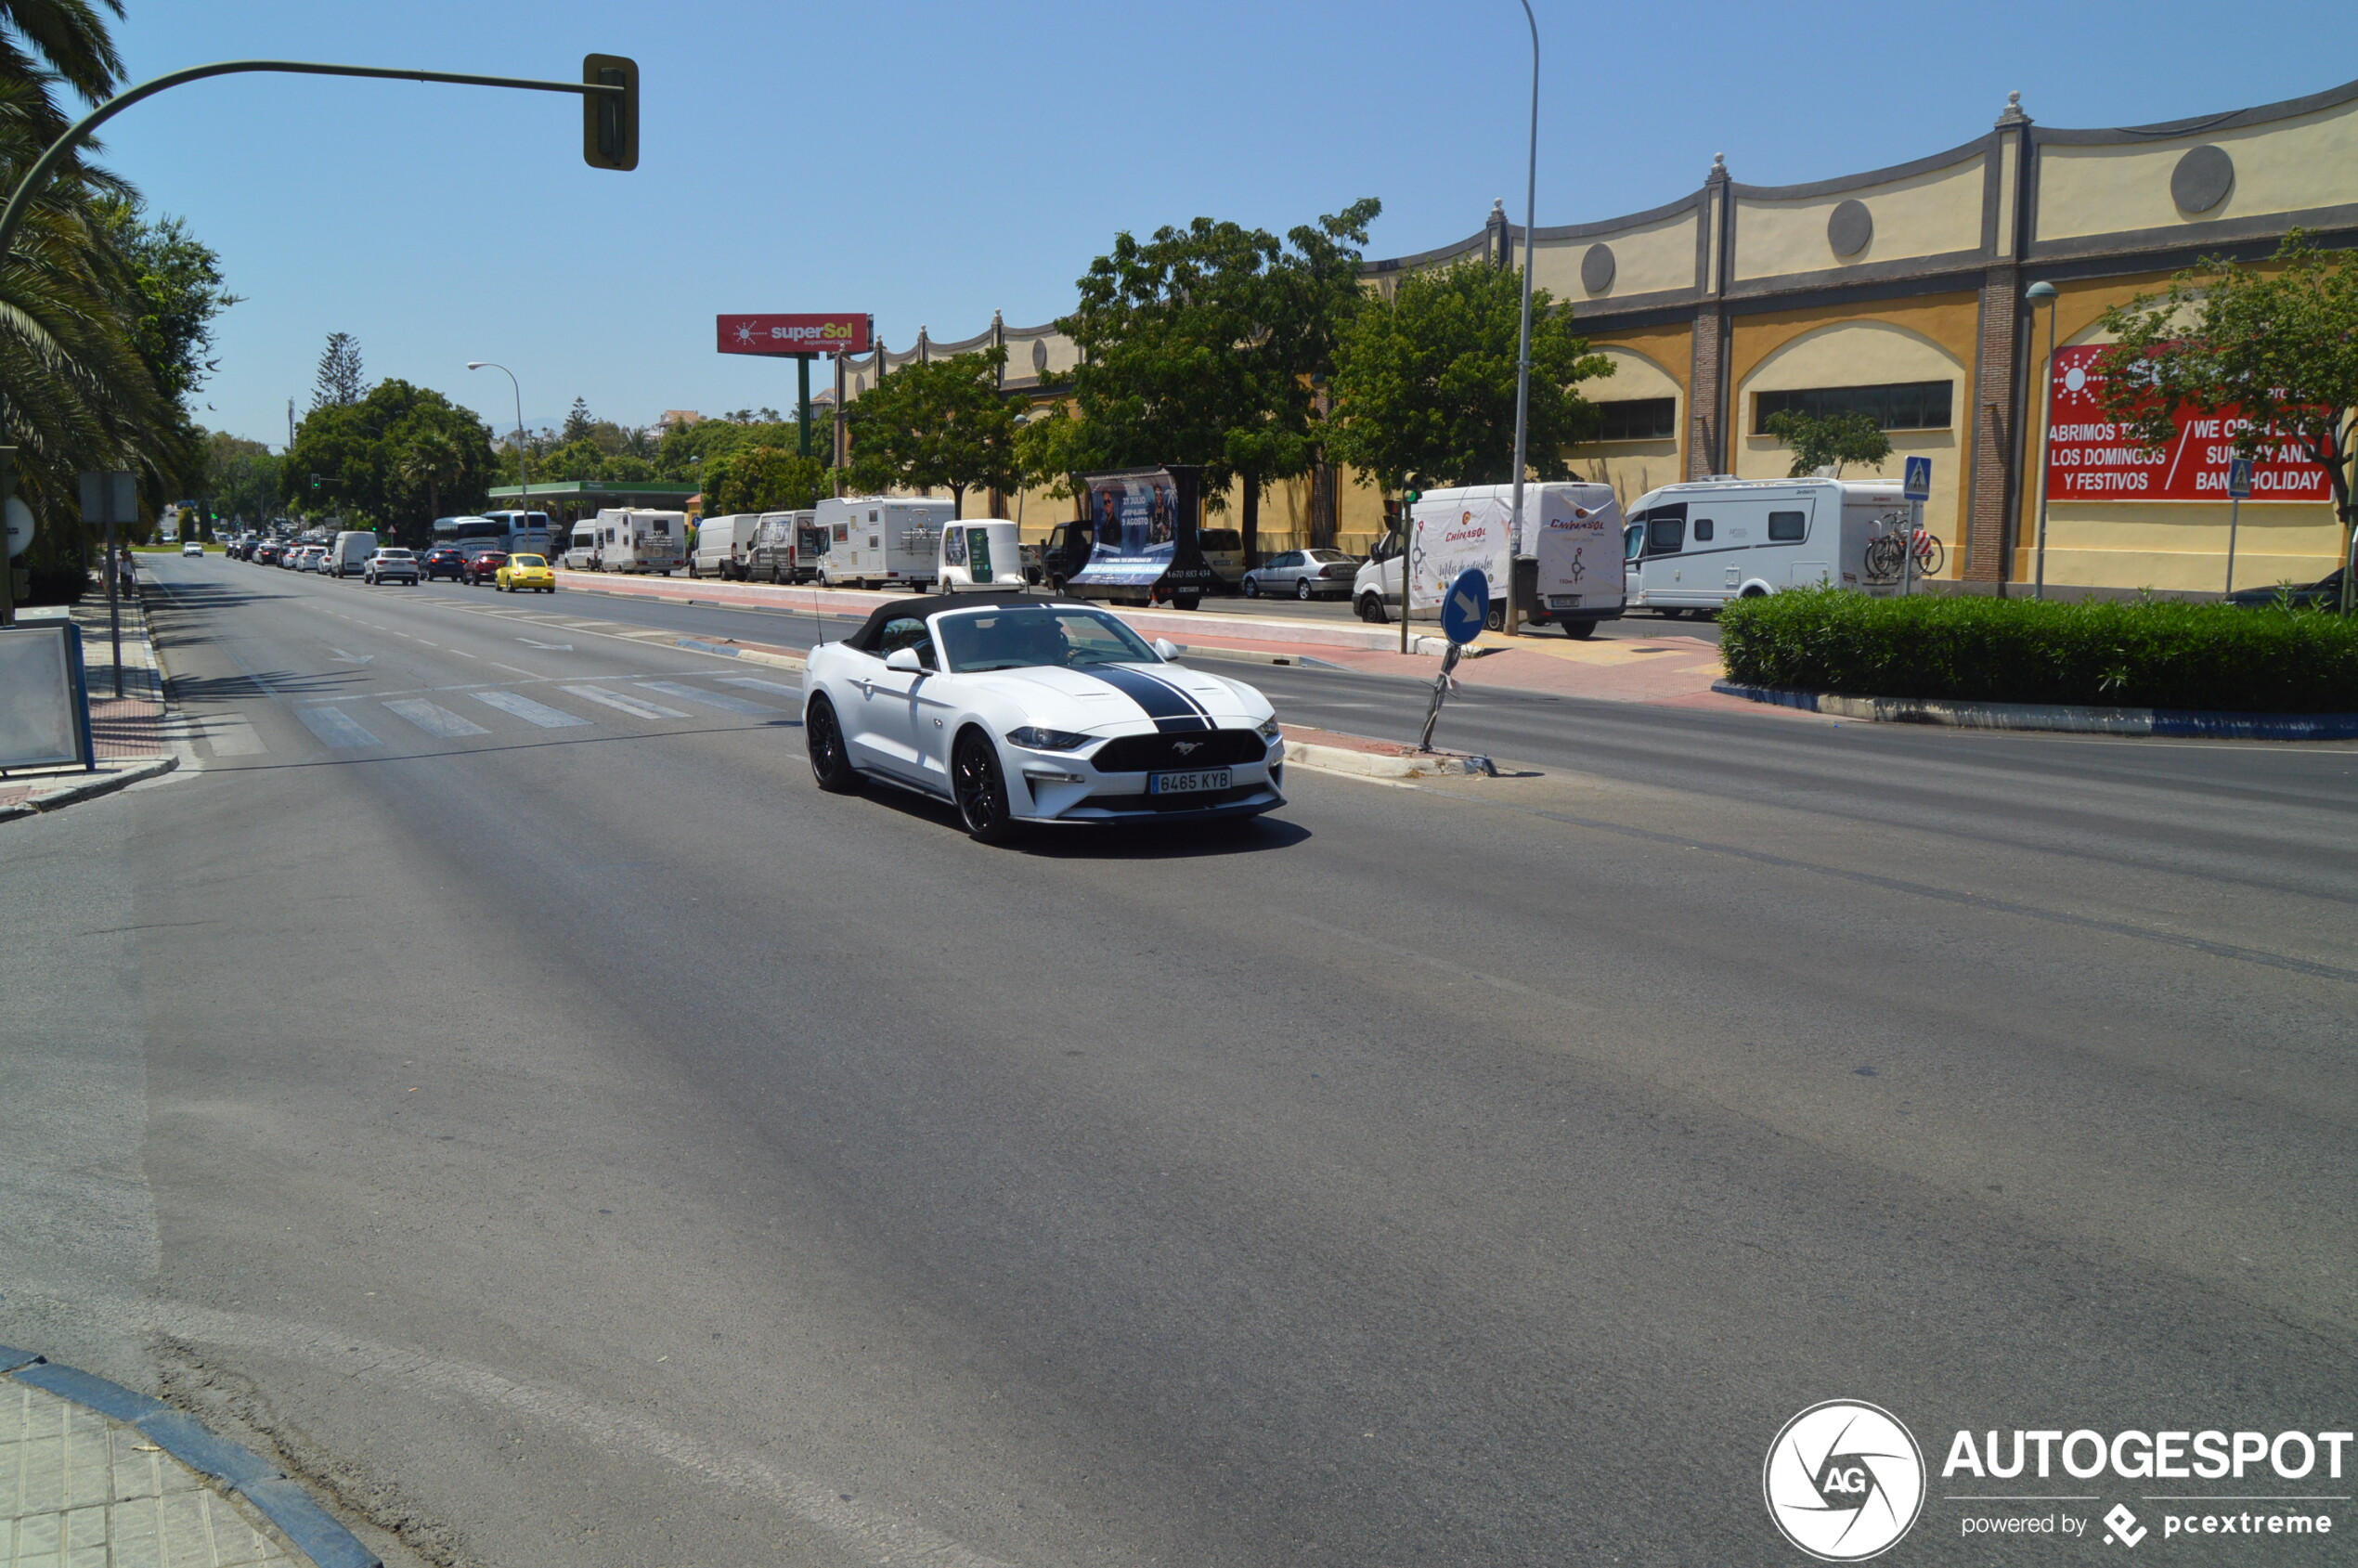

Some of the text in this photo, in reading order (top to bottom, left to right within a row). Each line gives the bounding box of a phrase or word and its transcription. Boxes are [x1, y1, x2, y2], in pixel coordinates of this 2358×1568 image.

[771, 322, 852, 342] superSol
[2049, 423, 2115, 442] ABRIMOS
[2194, 420, 2220, 438] WE
[2052, 447, 2166, 466] LOS DOMINGOS
[2206, 444, 2315, 464] SUNAY AND
[2064, 472, 2149, 490] Y FESTIVOS
[2196, 471, 2323, 490] BAN HOLIDAY
[1130, 496, 1147, 505] JULIO
[1126, 517, 1149, 526] AGOSTO
[1172, 570, 1185, 578] 670
[1202, 772, 1228, 788] KYB
